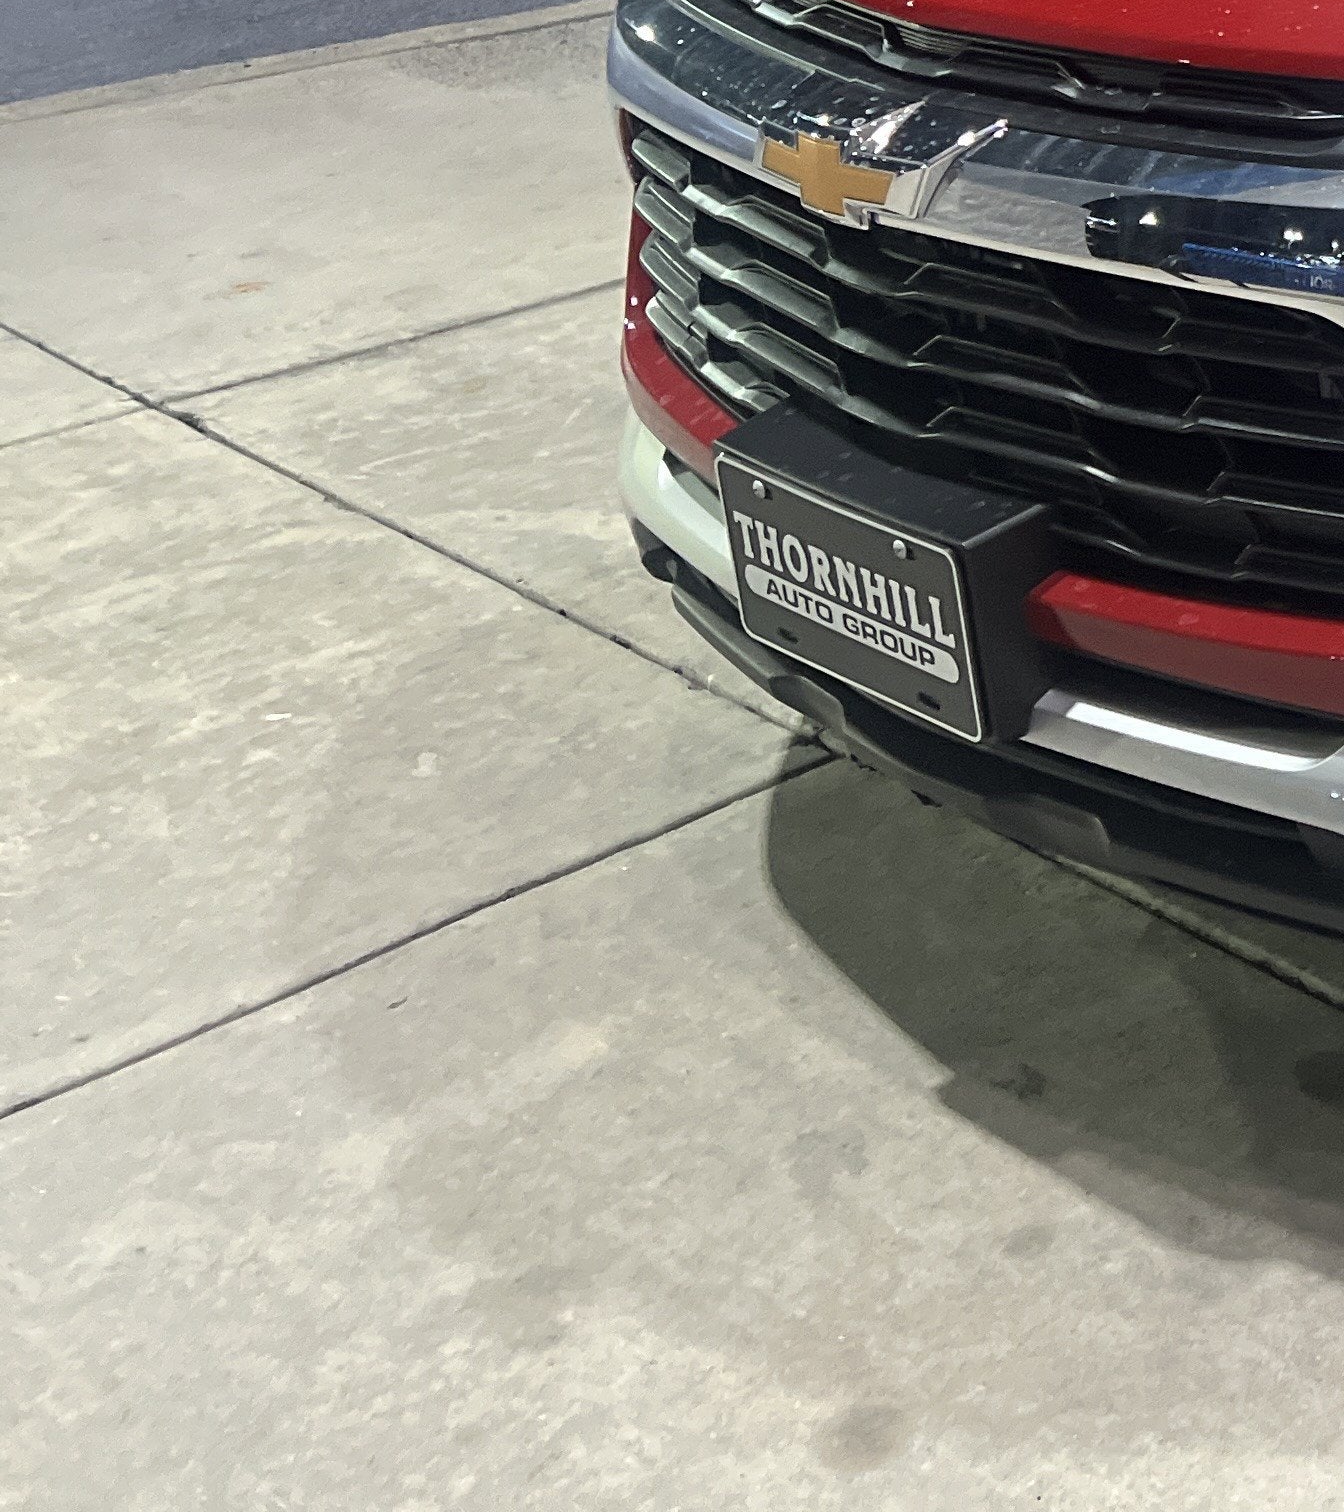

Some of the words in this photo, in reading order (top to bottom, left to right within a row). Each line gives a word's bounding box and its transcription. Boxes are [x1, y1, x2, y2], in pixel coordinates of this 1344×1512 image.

[733, 509, 957, 649] THORNHILL
[766, 578, 834, 625] AUTO
[842, 613, 937, 667] GROUP
